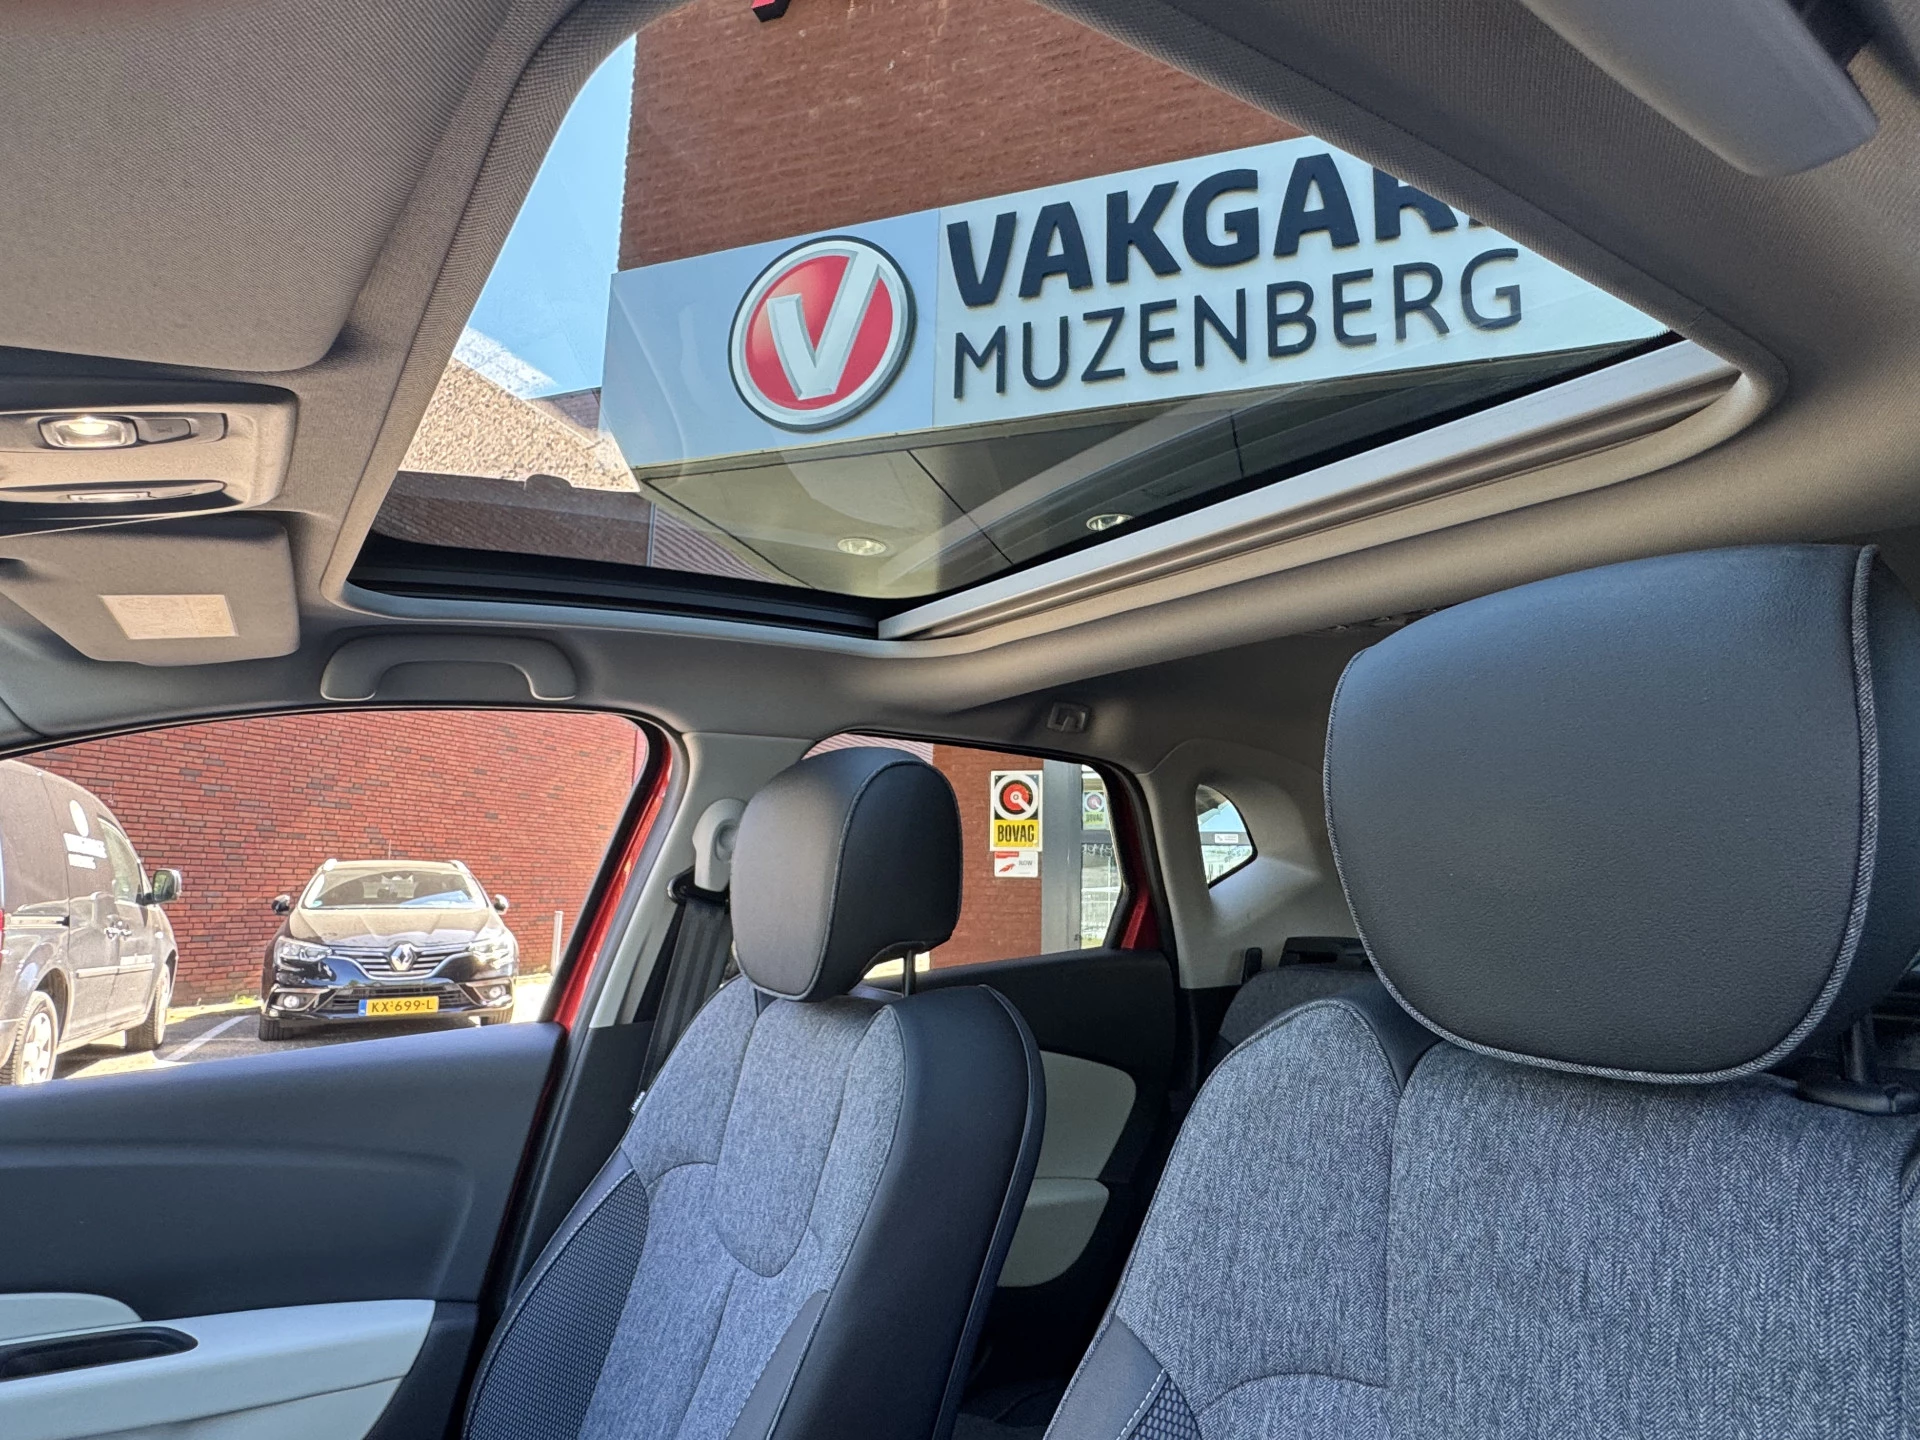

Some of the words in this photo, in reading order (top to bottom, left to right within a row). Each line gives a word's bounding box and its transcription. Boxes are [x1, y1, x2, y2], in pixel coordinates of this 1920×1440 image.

[947, 152, 1484, 308] VAKGAR
[766, 247, 882, 401] V
[954, 247, 1521, 399] MUZENBERG
[997, 824, 1035, 842] BOVAG
